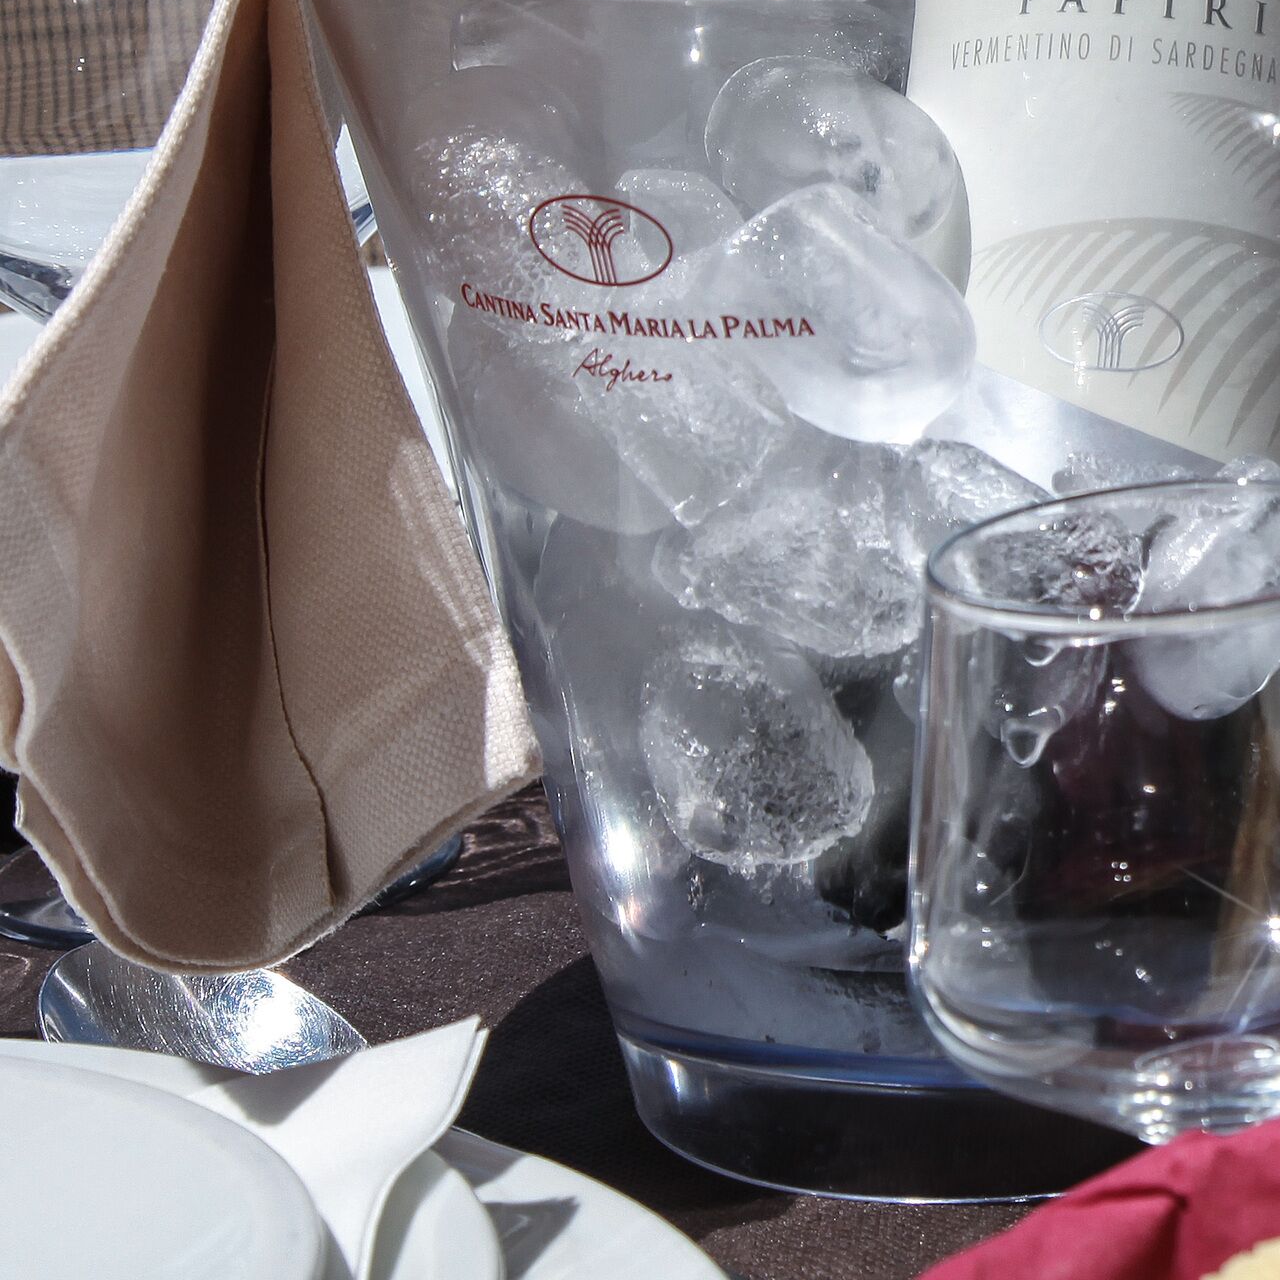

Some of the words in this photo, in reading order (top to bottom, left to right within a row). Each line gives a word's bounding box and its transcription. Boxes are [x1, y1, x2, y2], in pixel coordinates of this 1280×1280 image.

[951, 32, 1092, 70] VERMENTINO
[1108, 34, 1134, 63] DI
[1151, 37, 1278, 85] SARDEGNA
[460, 283, 538, 325] CANTINA
[540, 303, 606, 334] SANTA
[607, 310, 687, 340] MARIA
[688, 319, 717, 340] LA
[720, 315, 815, 340] PALMA
[572, 348, 673, 392] Alghero
